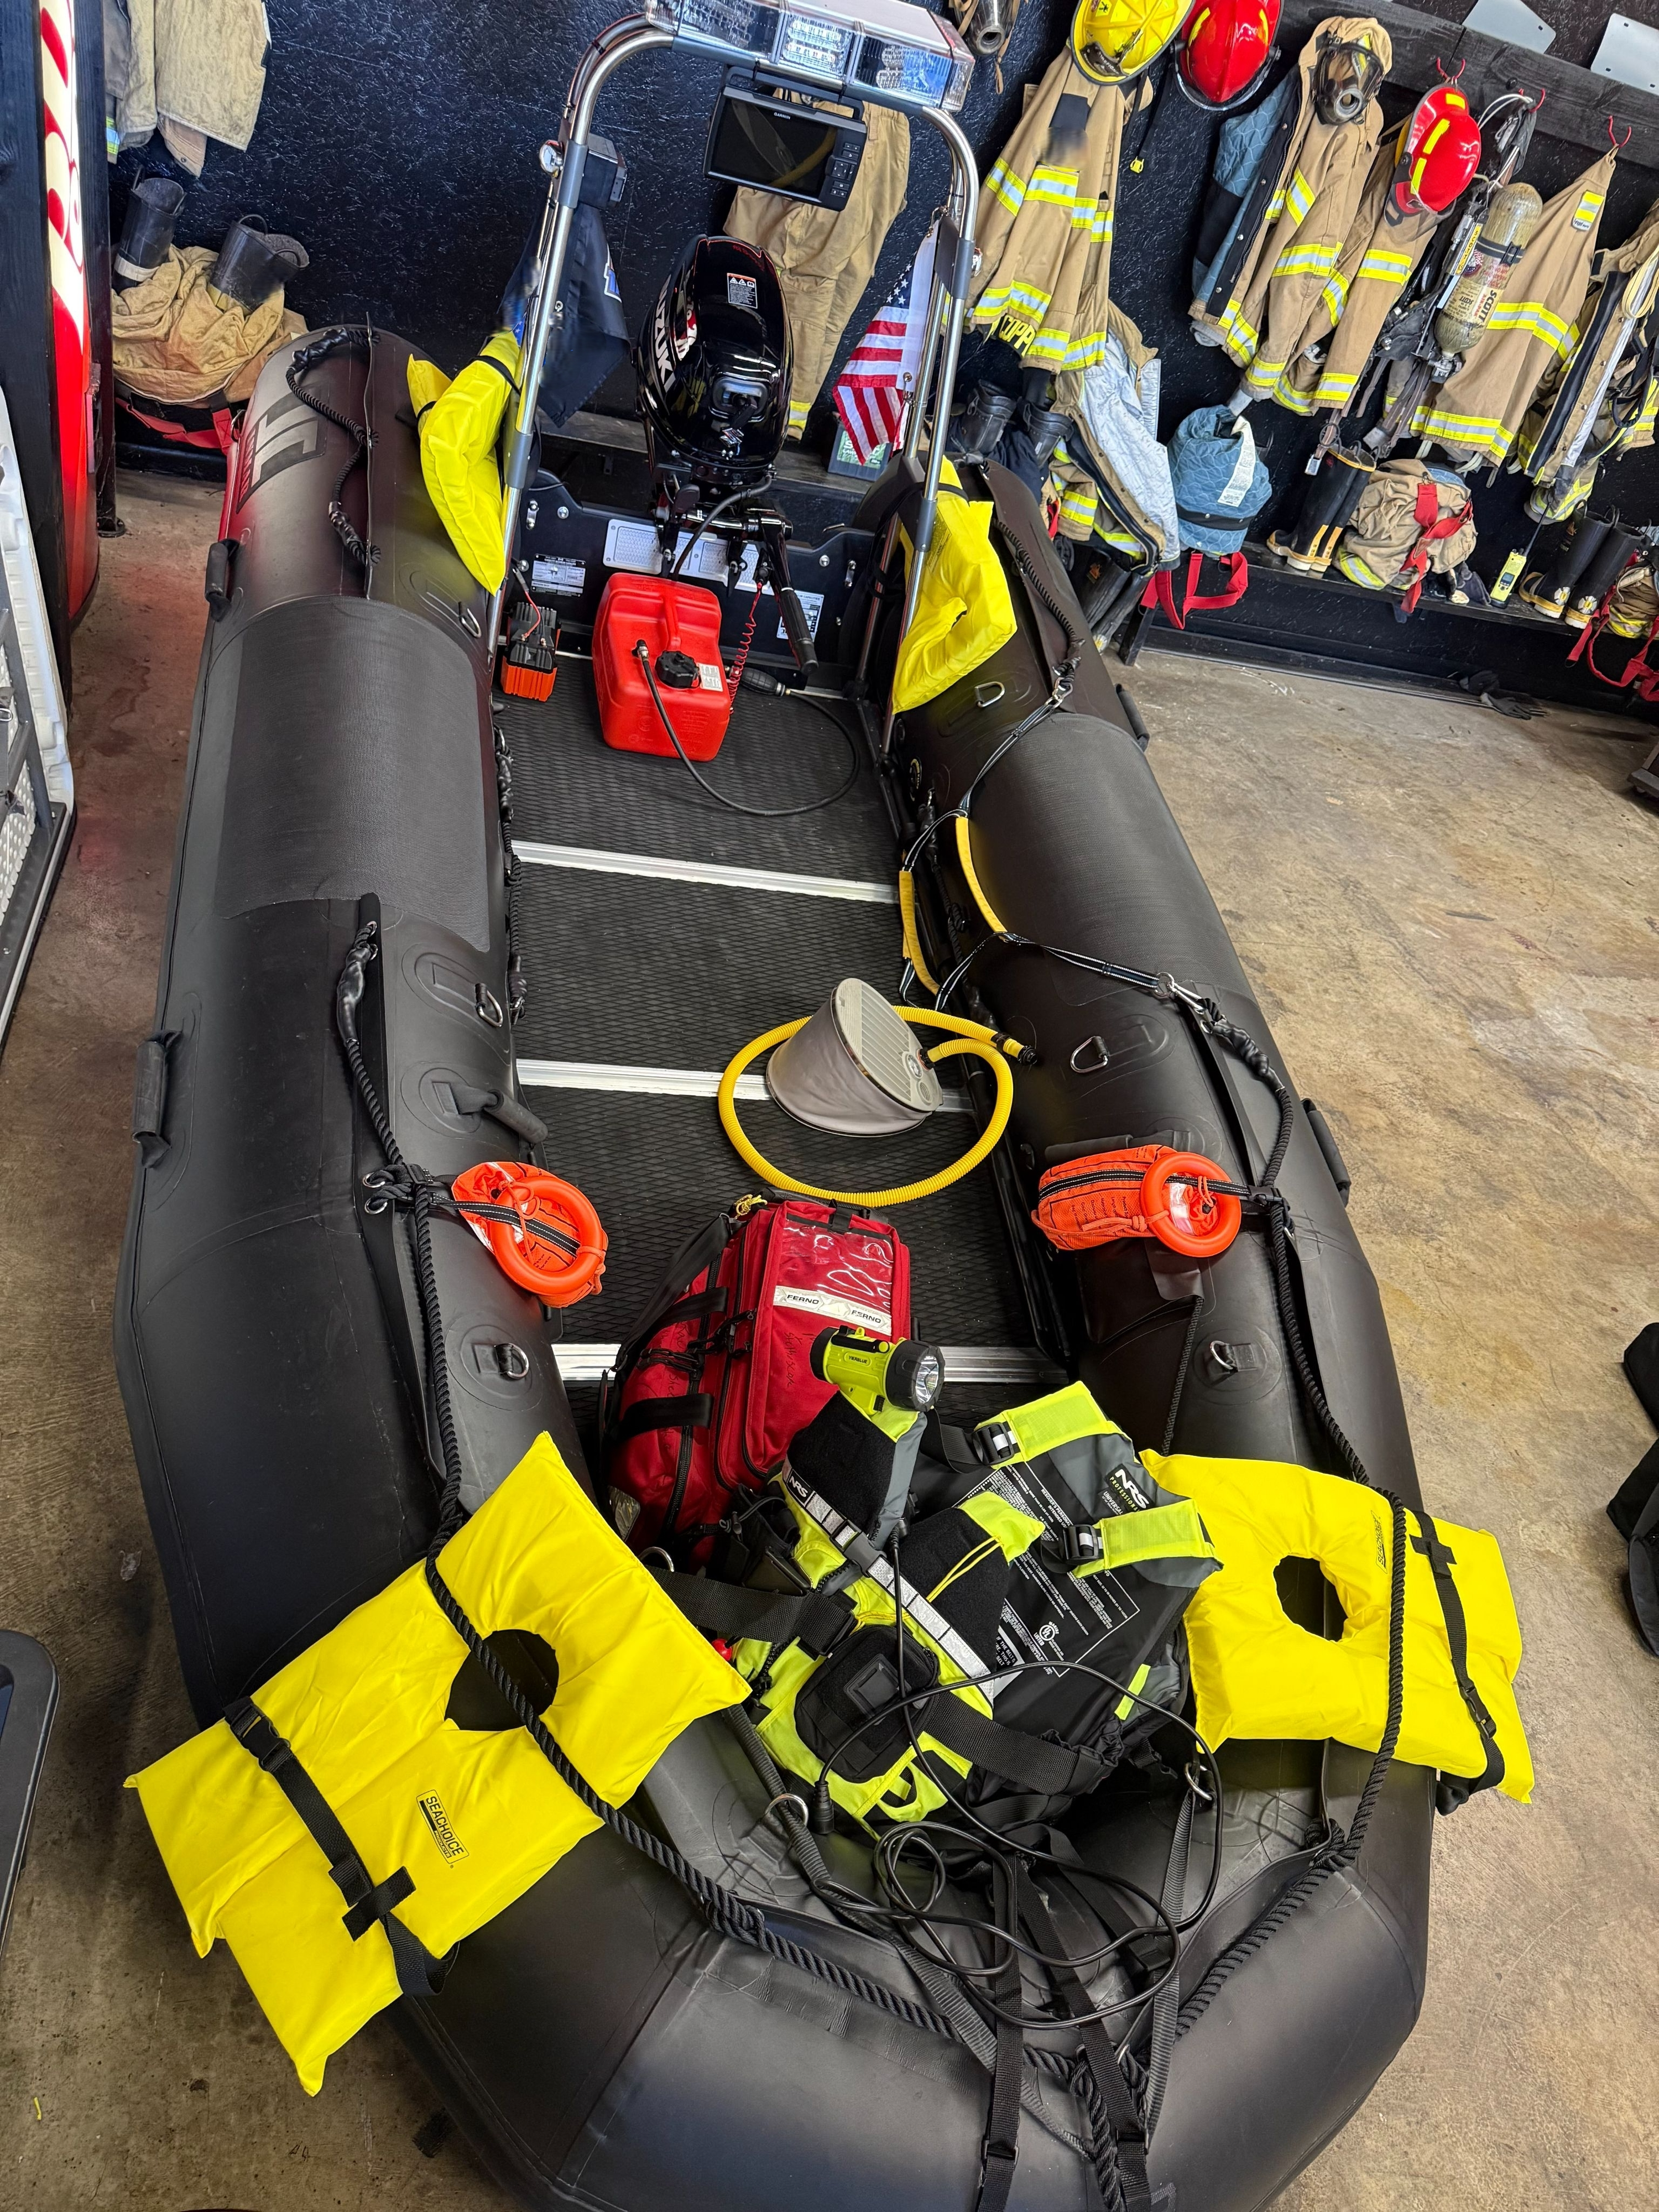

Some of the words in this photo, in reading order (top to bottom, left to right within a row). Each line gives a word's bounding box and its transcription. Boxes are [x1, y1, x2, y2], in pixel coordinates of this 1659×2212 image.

[774, 112, 791, 120] GARMIN
[1463, 230, 1478, 260] SCOTT
[1472, 293, 1488, 317] AIR-PAK
[1477, 290, 1498, 322] SCOTT
[655, 274, 676, 393] SUZUKI
[999, 314, 1035, 357] COPP
[787, 1293, 819, 1305] FERNO
[851, 1310, 881, 1323] FERNO
[789, 1475, 808, 1496] NRS
[1114, 1467, 1150, 1511] NRS
[1040, 1488, 1057, 1509] RESCUER'S
[1055, 1507, 1071, 1527] PERSONAL
[1047, 1504, 1063, 1523] INTENDED
[1103, 1490, 1123, 1516] UNIVERSAL
[999, 1641, 1008, 1650] THE
[1005, 1649, 1014, 1659] BELT
[1032, 1632, 1045, 1646] LISTED
[995, 1655, 1005, 1666] BELT
[999, 1651, 1009, 1662] THIS
[425, 1794, 464, 1856] SEACHOICE
[434, 1829, 450, 1857] PRODUCTS
